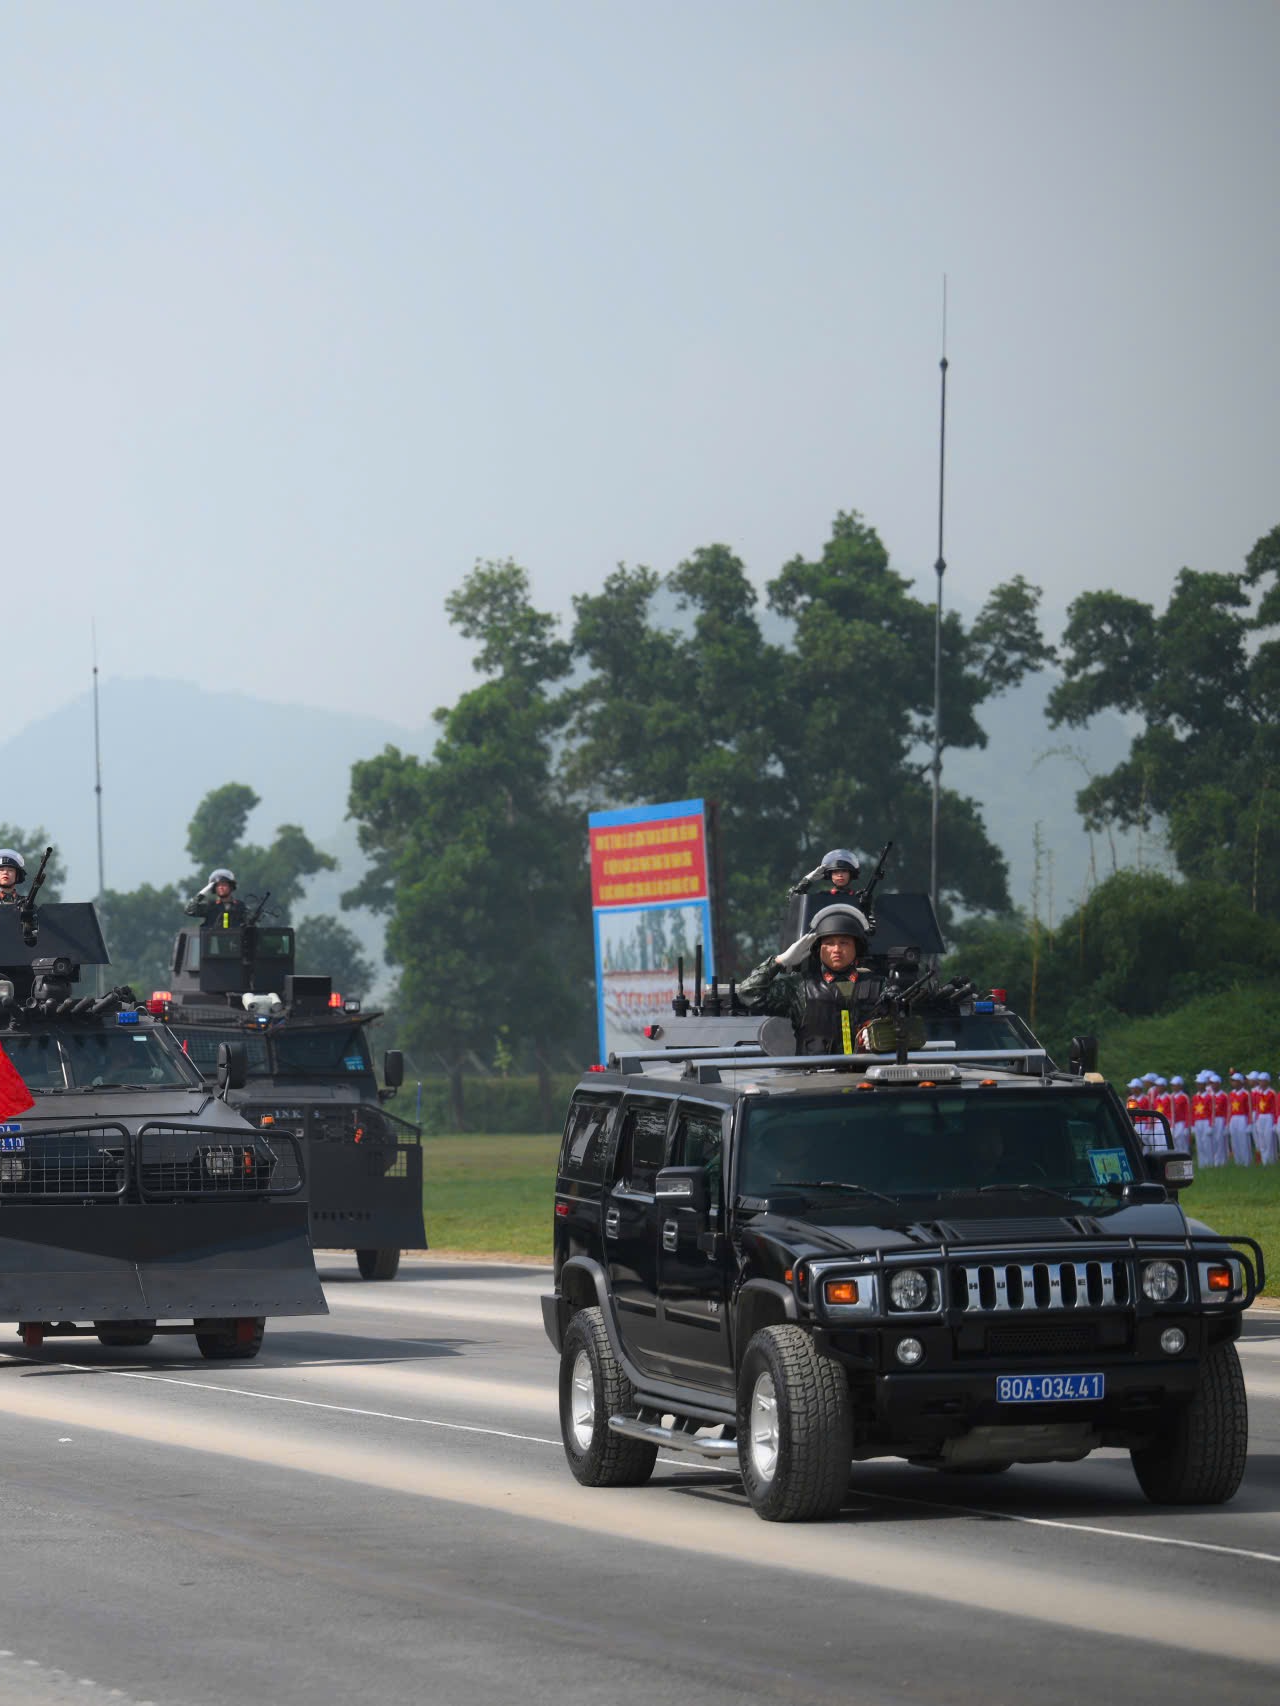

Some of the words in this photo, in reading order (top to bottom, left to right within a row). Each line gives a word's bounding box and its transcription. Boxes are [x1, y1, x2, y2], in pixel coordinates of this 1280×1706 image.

[275, 1110, 320, 1118] INKS
[968, 1278, 1112, 1290] HUMMER
[1000, 1376, 1100, 1399] 80A-034.41
